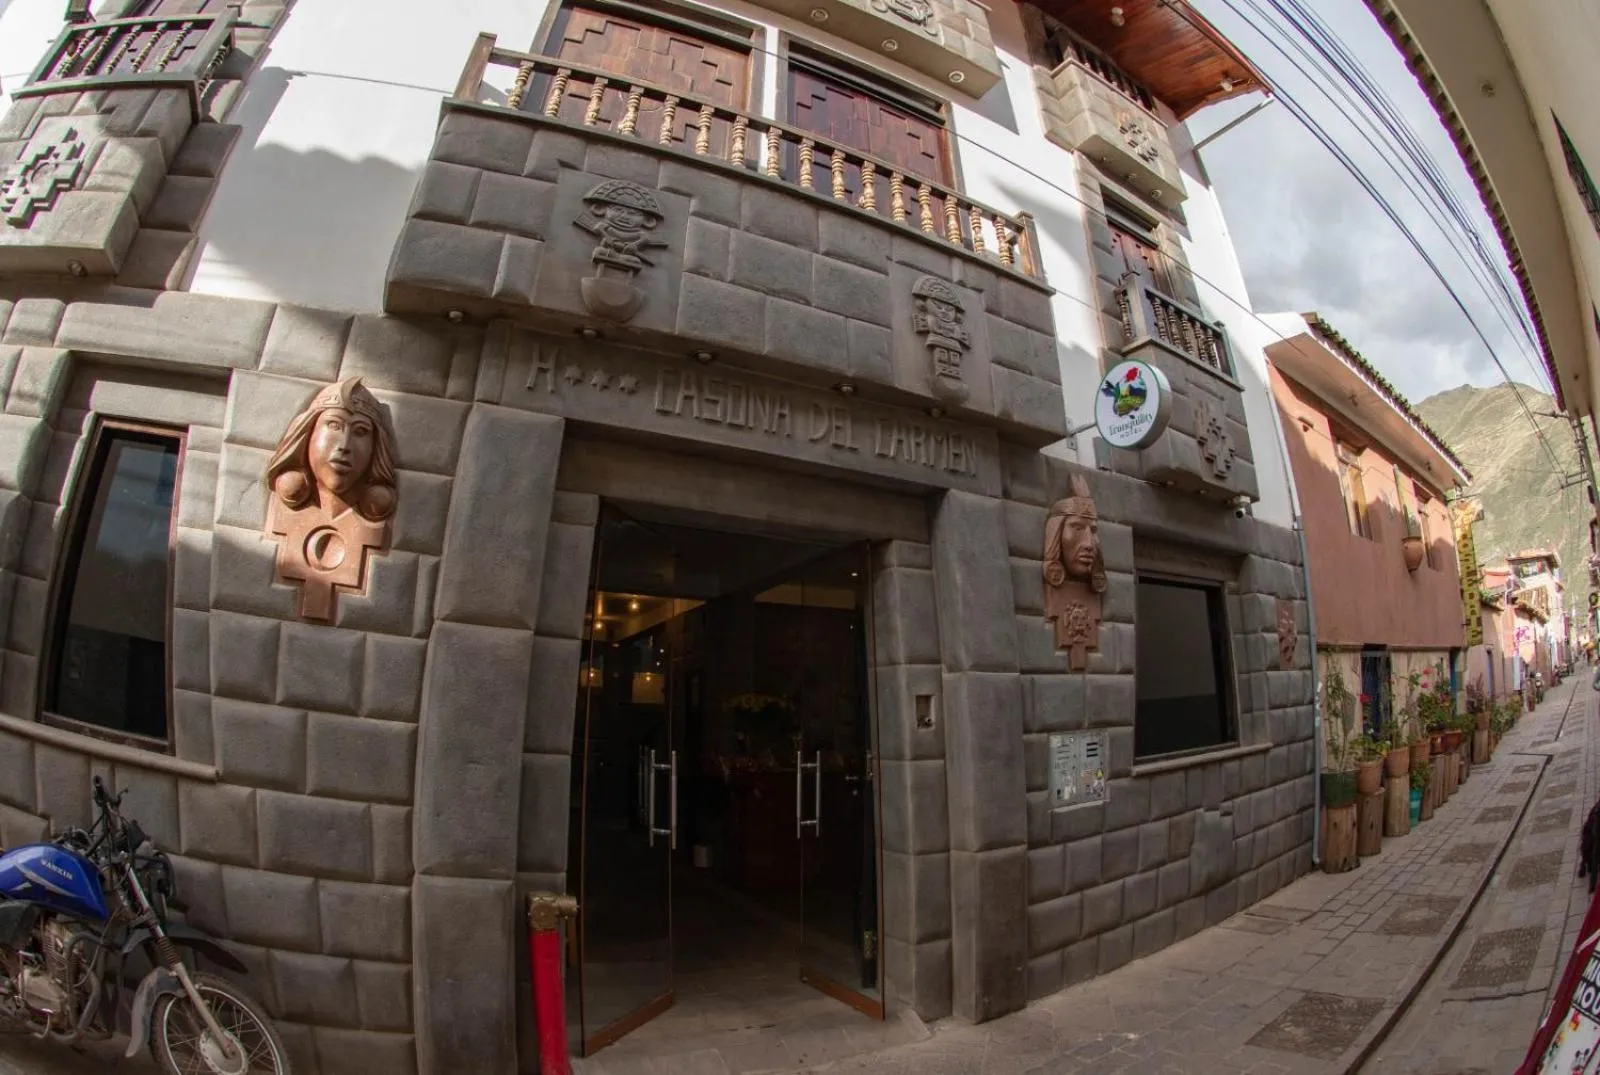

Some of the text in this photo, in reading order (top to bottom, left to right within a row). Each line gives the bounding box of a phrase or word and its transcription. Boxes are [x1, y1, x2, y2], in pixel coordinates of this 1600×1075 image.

[654, 368, 793, 438] CASONA
[808, 402, 858, 452] DEL
[873, 417, 977, 477] CARMEN
